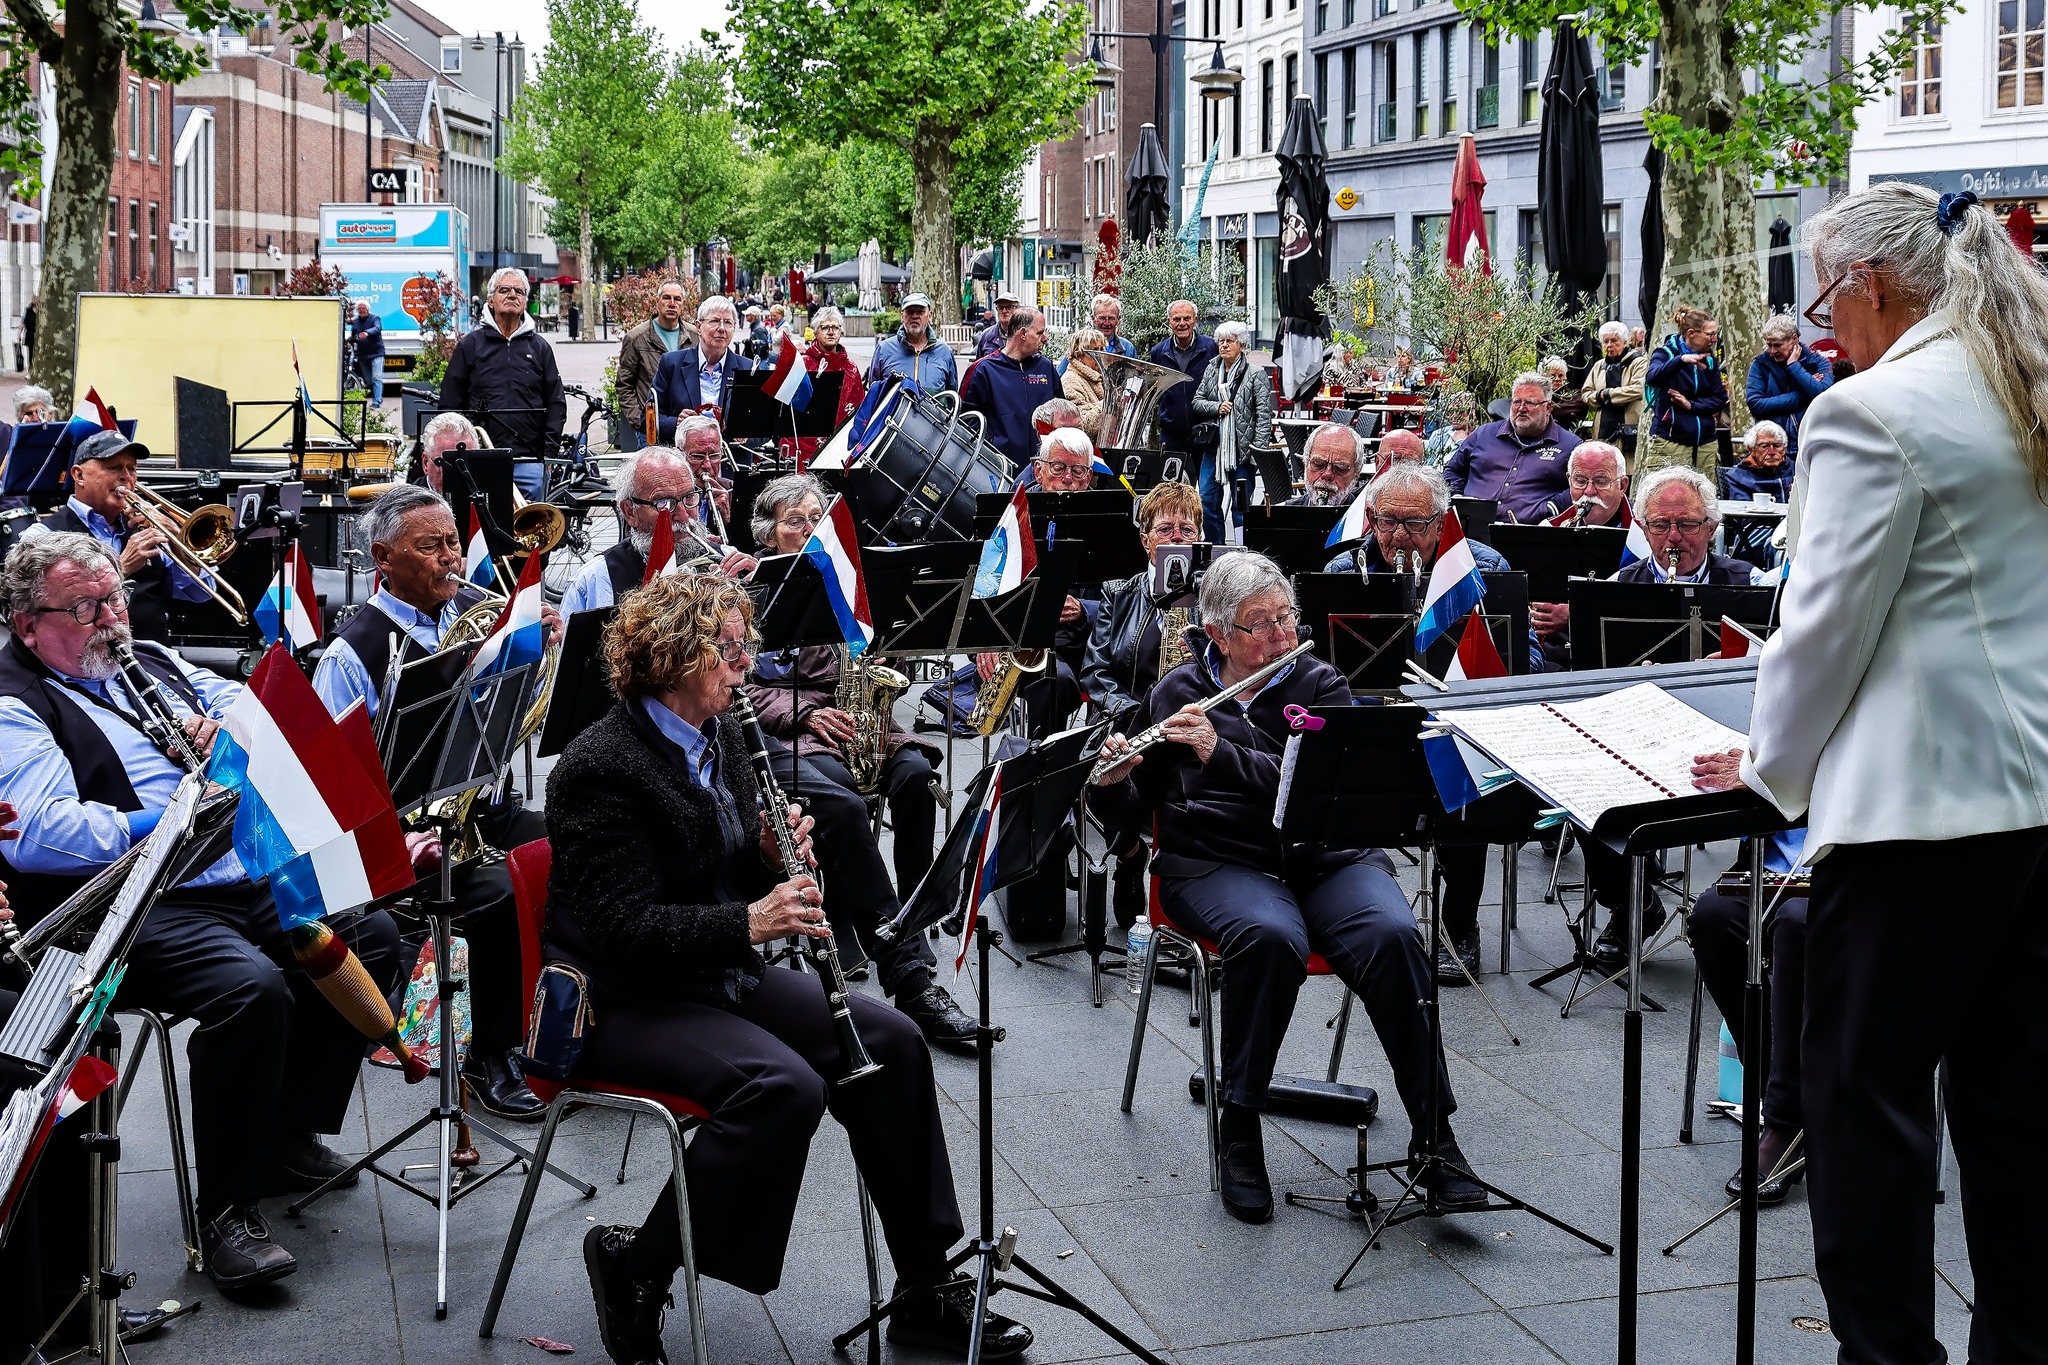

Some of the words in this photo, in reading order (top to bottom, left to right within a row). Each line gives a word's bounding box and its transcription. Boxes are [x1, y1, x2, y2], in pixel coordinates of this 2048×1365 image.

[371, 172, 400, 190] C&A
[346, 282, 369, 292] eze
[370, 280, 393, 292] bus
